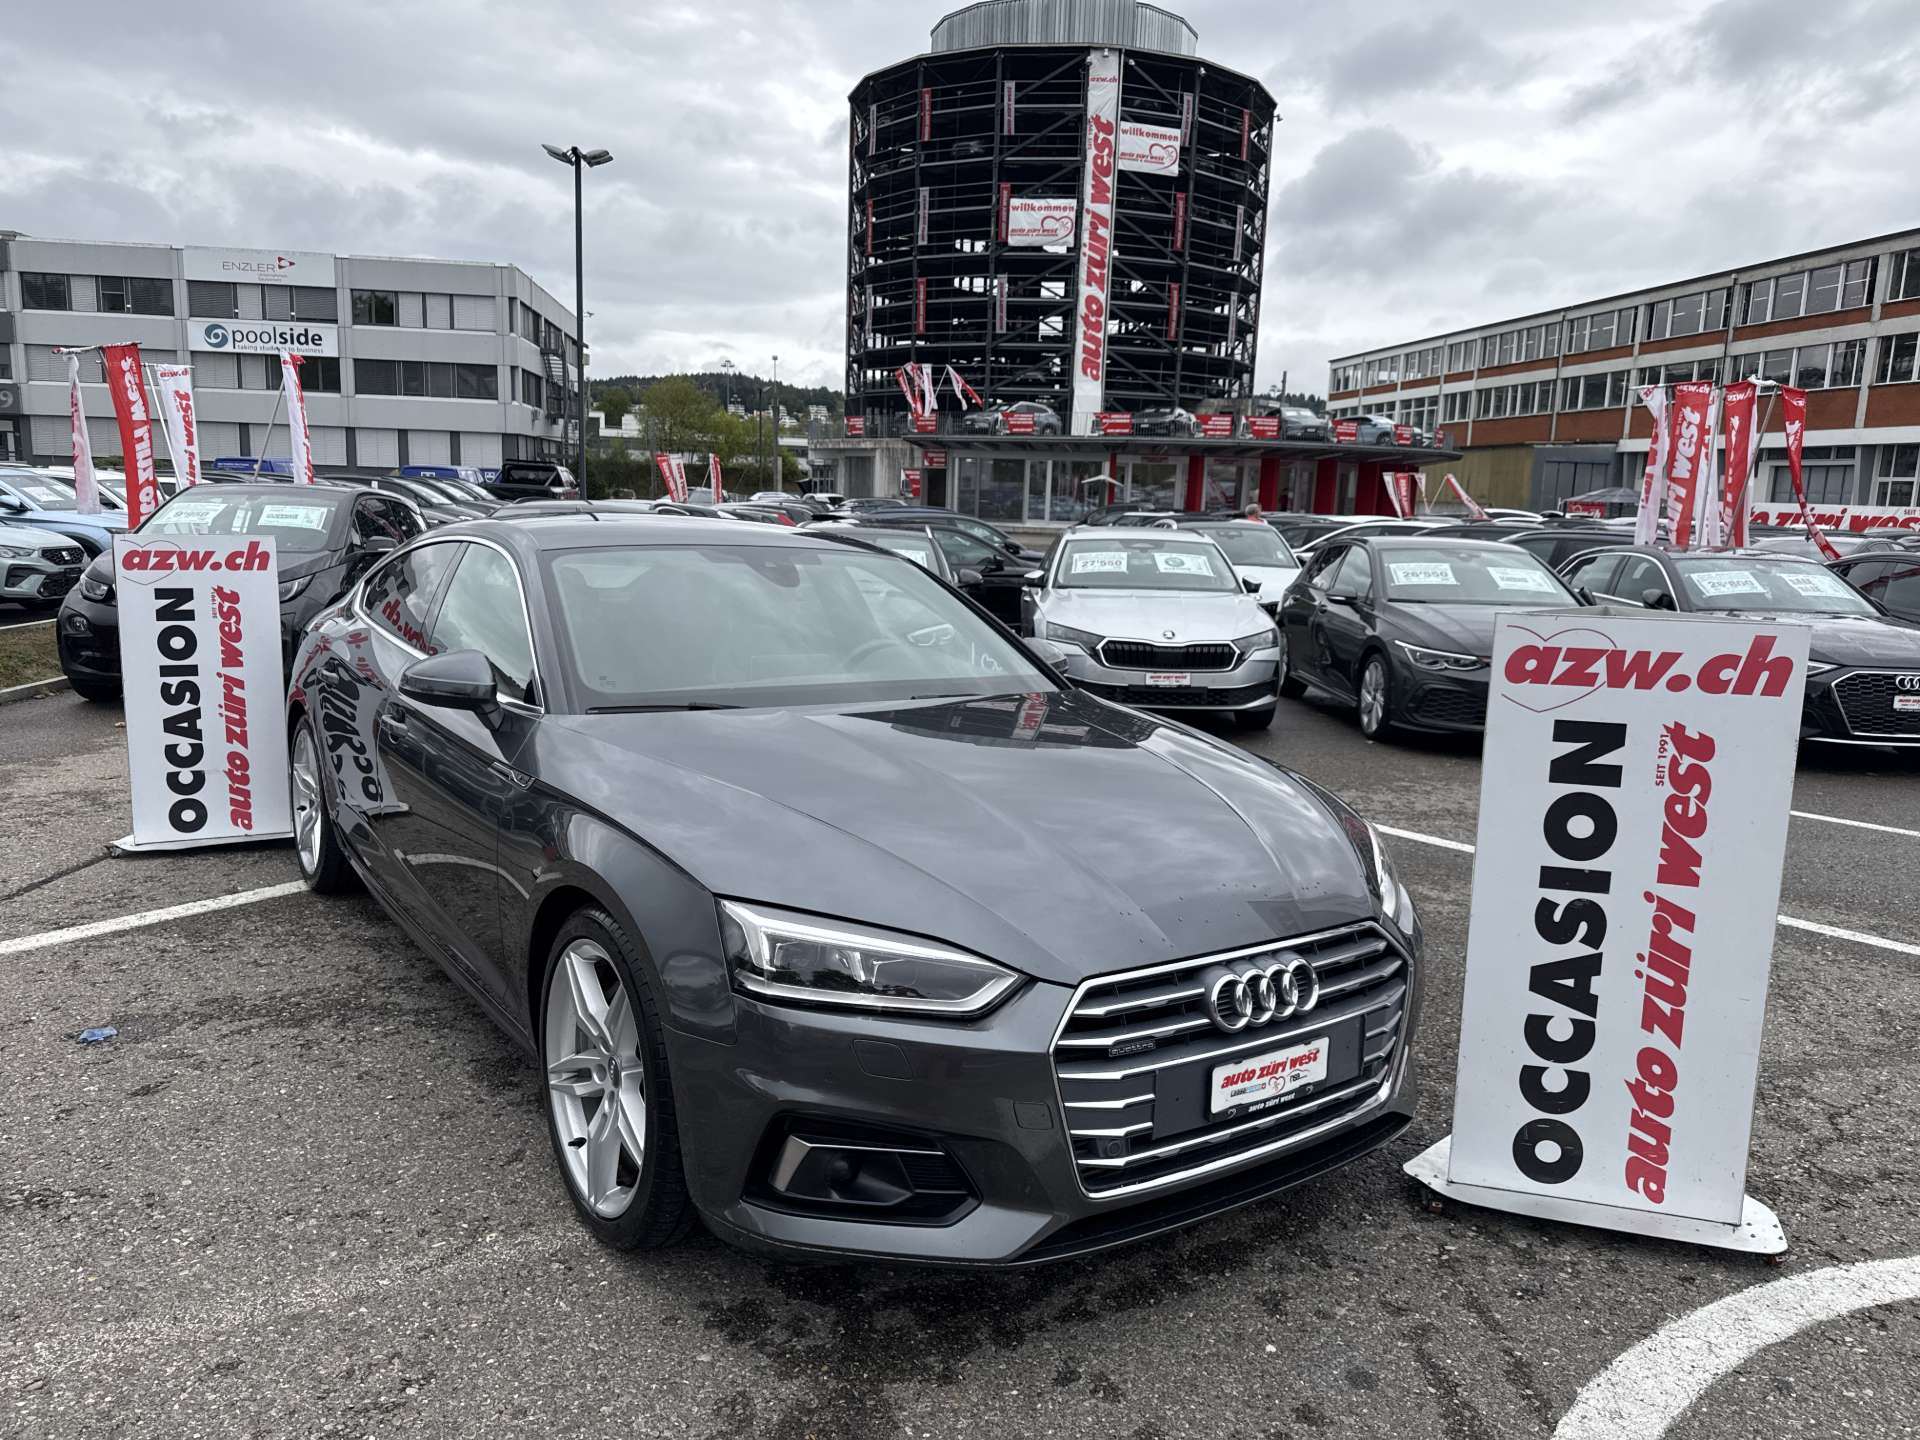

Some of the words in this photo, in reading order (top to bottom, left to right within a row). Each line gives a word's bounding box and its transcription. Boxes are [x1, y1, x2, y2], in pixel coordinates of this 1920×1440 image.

[1091, 113, 1114, 204] west
[1121, 127, 1179, 142] willkommen
[1011, 203, 1075, 212] willkommen
[222, 261, 275, 273] ENZLER
[1083, 207, 1110, 293] züri
[232, 326, 323, 349] poolside
[1081, 294, 1105, 381] auto
[1671, 406, 1701, 479] west
[121, 541, 270, 571] azw.ch
[211, 584, 243, 668] west
[1504, 635, 1794, 698] azw.ch
[154, 587, 208, 834] OCCASION
[216, 671, 249, 750] züri
[1658, 734, 1669, 759] 1991
[223, 751, 254, 831] auto
[1655, 764, 1666, 787] SEIT
[1657, 720, 1716, 888] west
[1512, 719, 1628, 1185] OCCASION
[1634, 890, 1696, 1050] züri
[1221, 1067, 1257, 1089] auto
[1257, 1057, 1289, 1080] züri
[1289, 1048, 1320, 1070] west
[1248, 1102, 1265, 1113] auto
[1265, 1097, 1280, 1108] züri
[1280, 1092, 1296, 1104] west
[1624, 1048, 1679, 1204] auto
